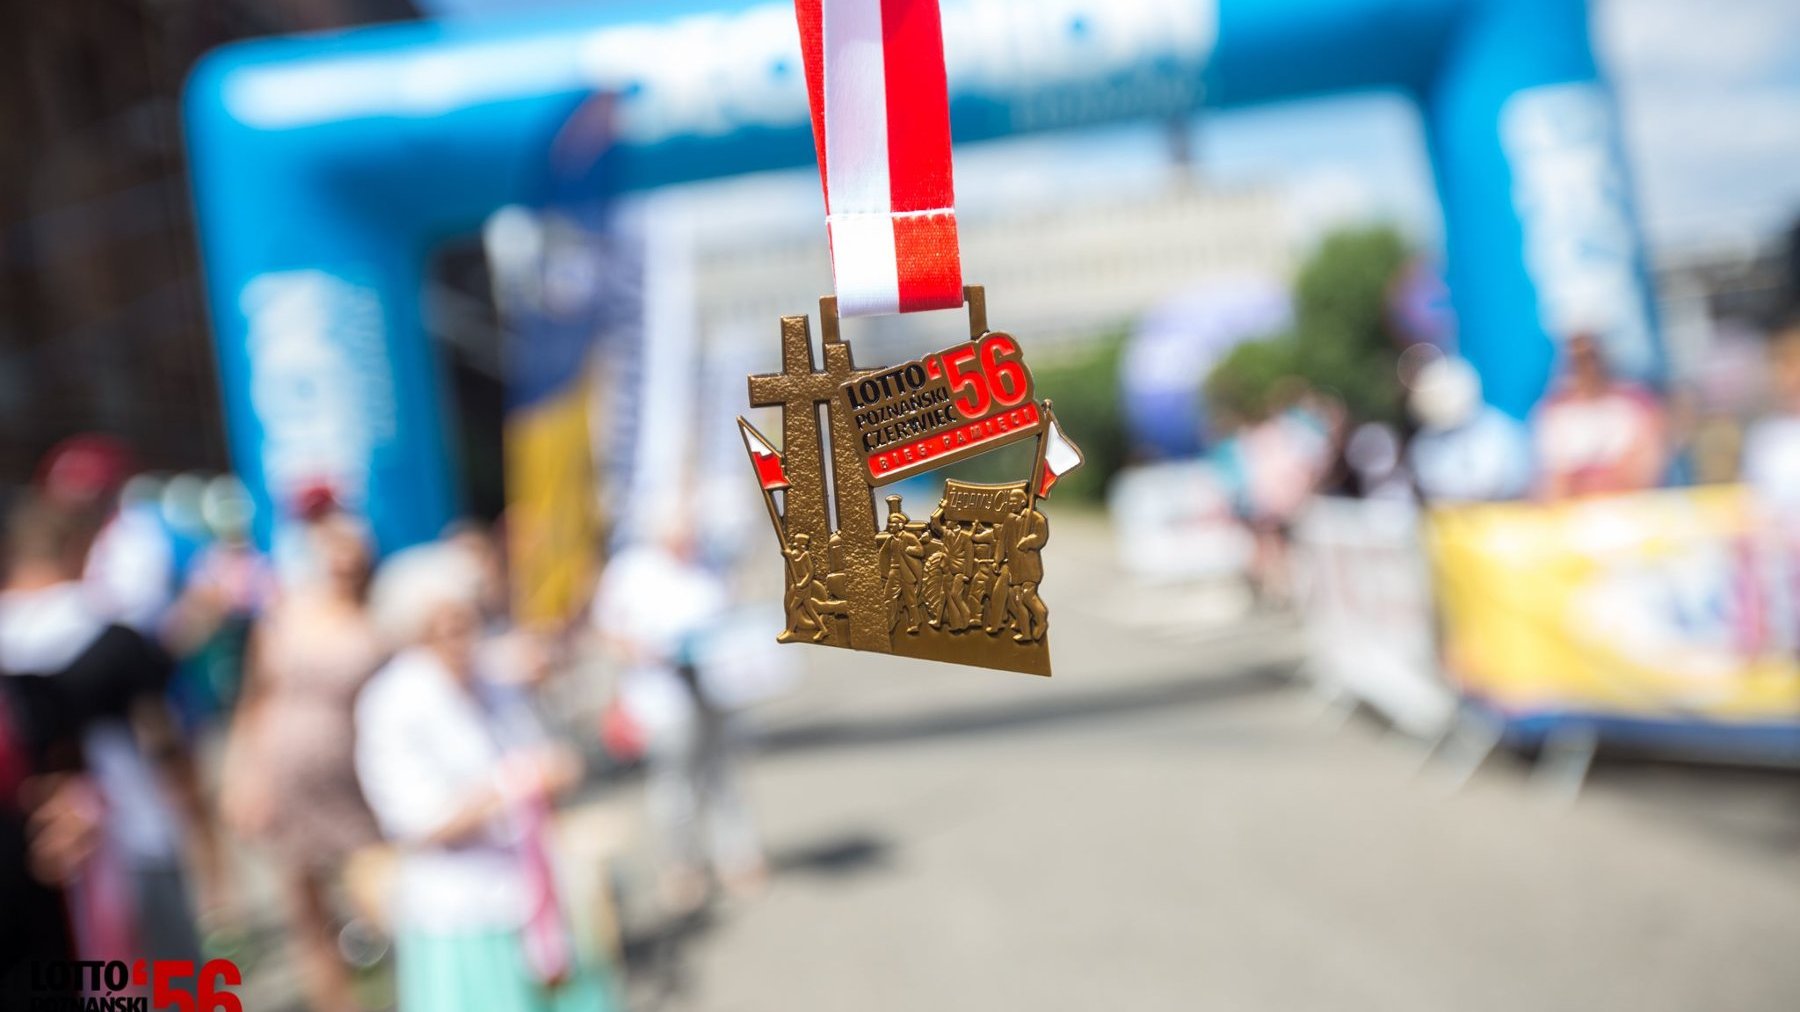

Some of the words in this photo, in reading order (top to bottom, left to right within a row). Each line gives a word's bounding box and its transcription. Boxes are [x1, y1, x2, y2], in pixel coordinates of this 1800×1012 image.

[846, 363, 926, 411] LOTTO
[855, 386, 950, 431] POZNAŃSKI
[862, 404, 957, 452] CZERWIEC
[879, 444, 928, 469] BIEG
